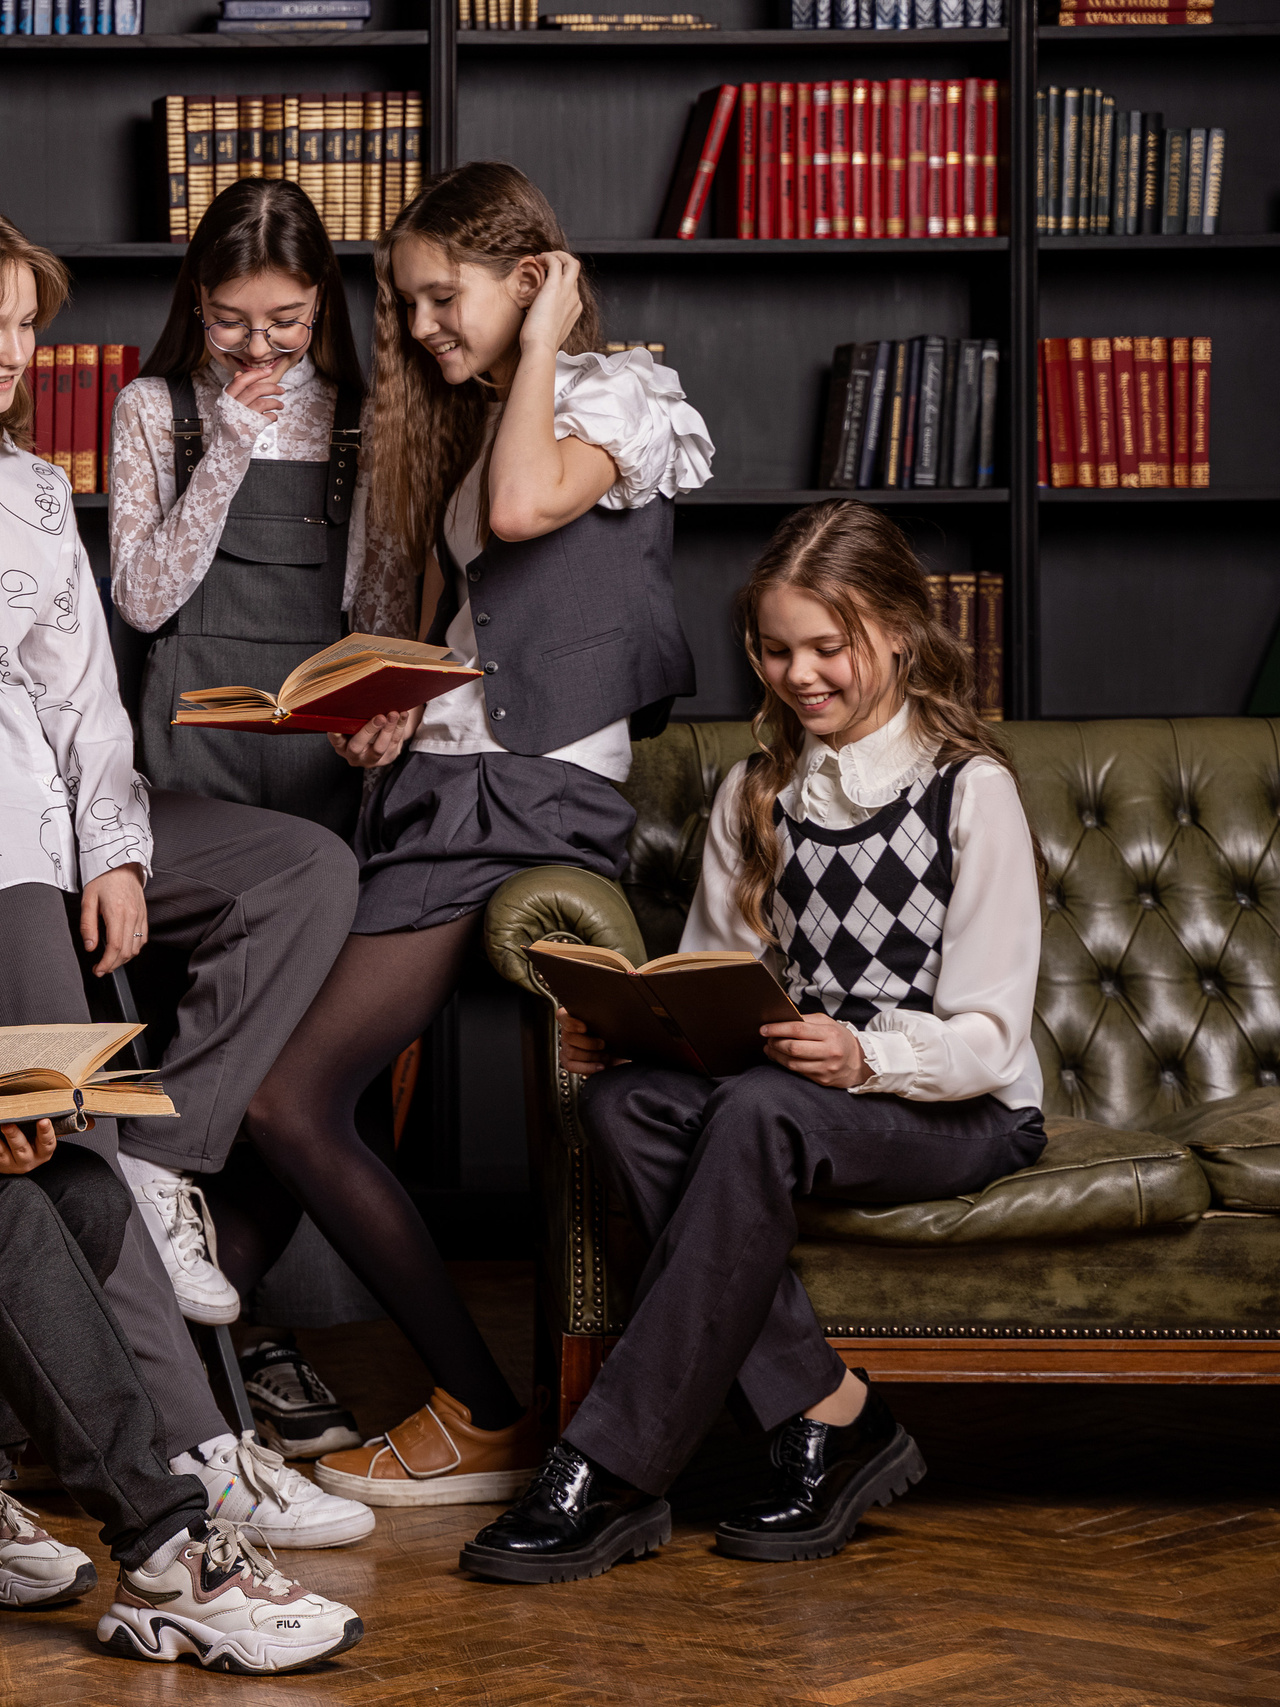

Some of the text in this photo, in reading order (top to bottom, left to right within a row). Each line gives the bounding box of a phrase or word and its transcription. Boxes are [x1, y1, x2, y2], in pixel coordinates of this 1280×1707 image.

[39, 374, 51, 392] 7
[78, 369, 92, 389] 9
[276, 1620, 301, 1629] FILA
